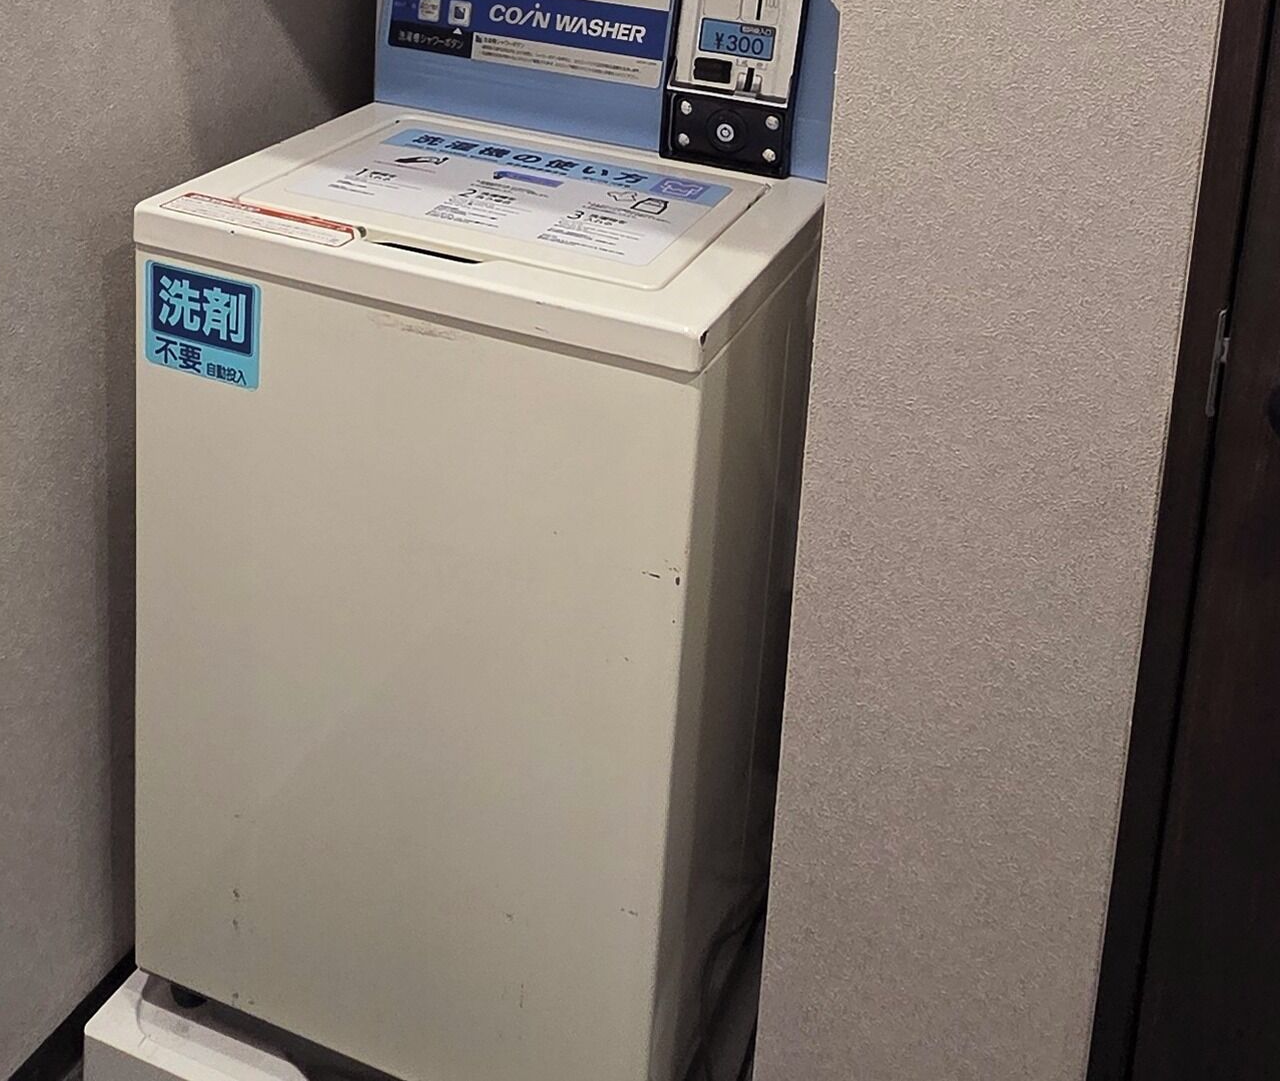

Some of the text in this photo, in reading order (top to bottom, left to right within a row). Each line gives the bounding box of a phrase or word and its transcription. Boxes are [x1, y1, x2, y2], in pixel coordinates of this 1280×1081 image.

[555, 15, 647, 44] WASHER
[715, 31, 764, 56] ¥300
[412, 133, 649, 184] 洗濯機の使い方
[158, 275, 246, 344] 洗剤
[154, 336, 247, 386] 不要 自動投入
